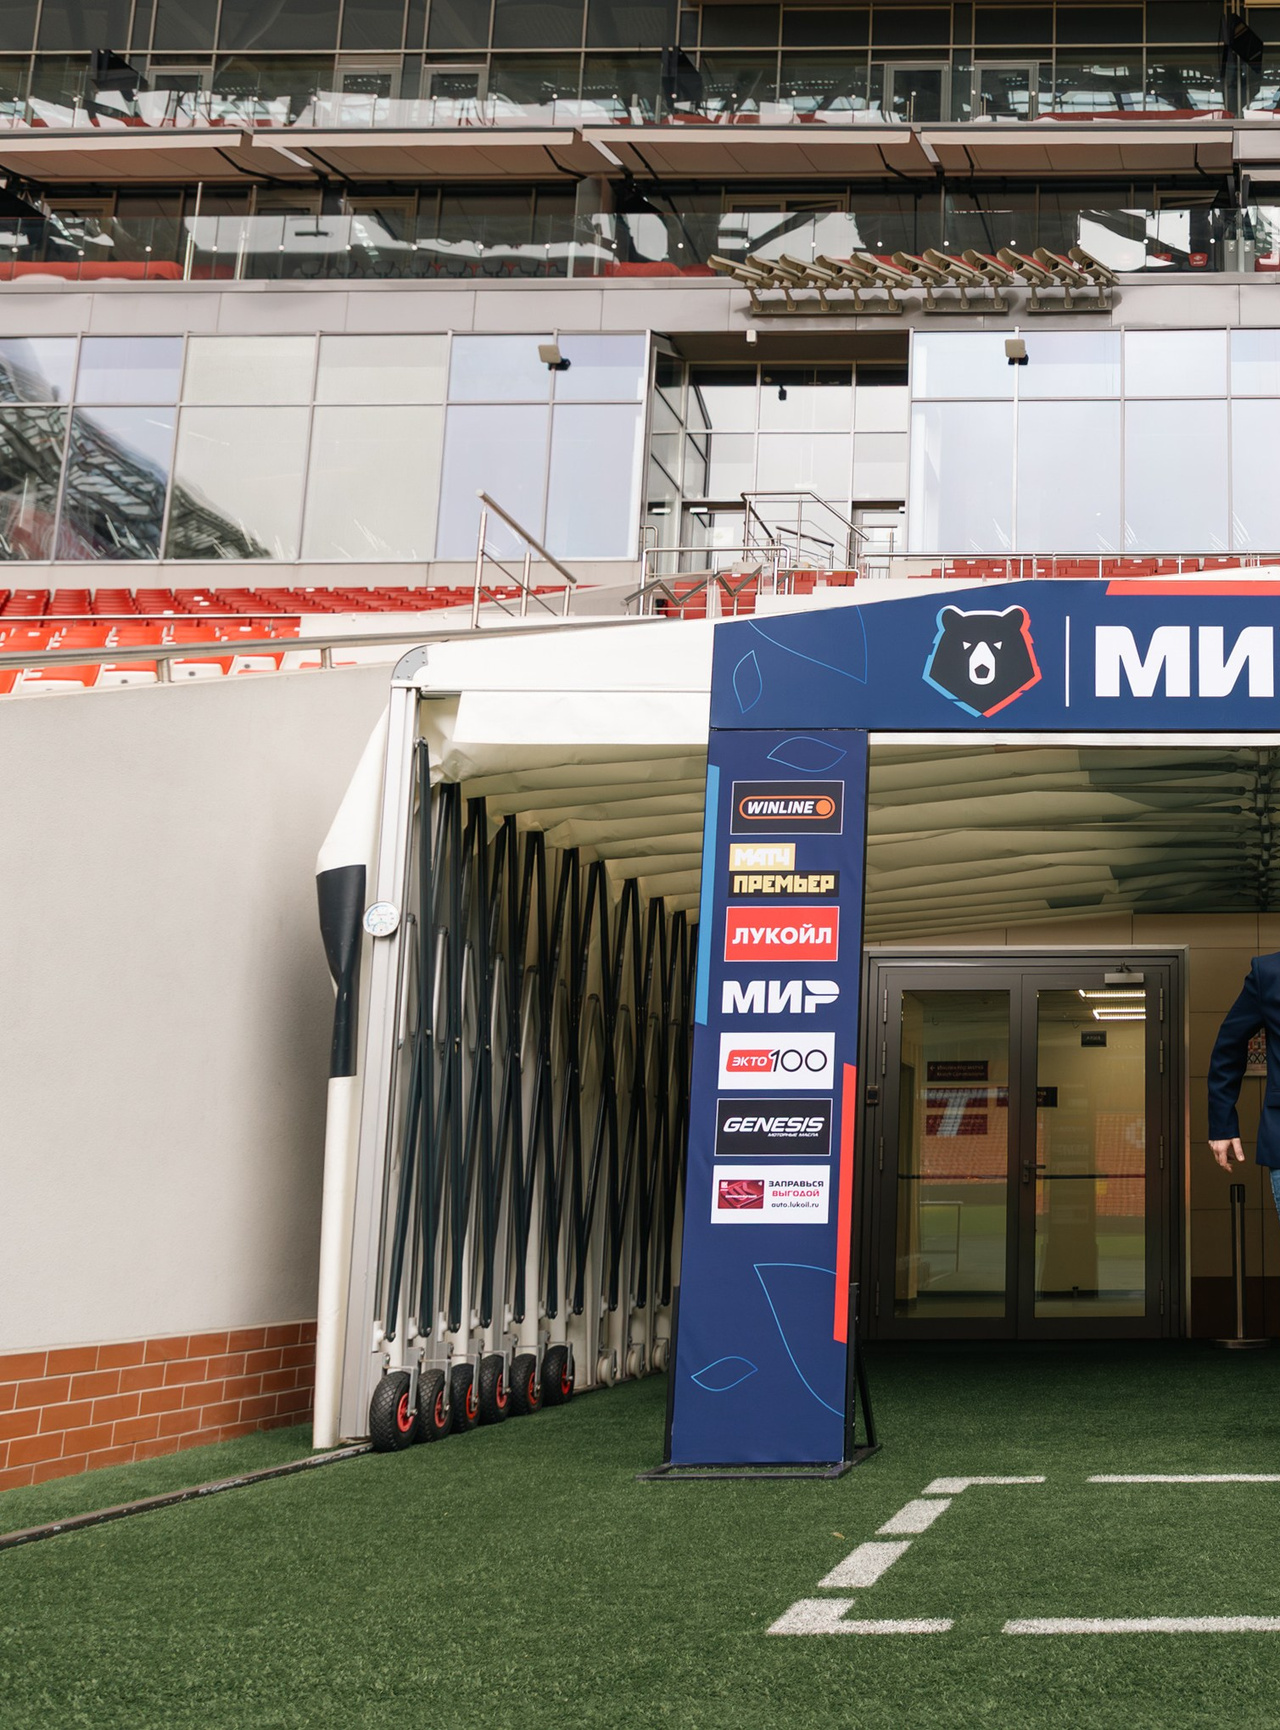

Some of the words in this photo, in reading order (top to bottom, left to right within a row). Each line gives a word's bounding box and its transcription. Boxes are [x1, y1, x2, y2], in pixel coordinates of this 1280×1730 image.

[747, 801, 815, 815] WINLINE
[733, 847, 791, 867] МАТЧ
[732, 874, 836, 894] ПРЕМЬЕР
[731, 923, 833, 945] ЛУКОЙЛ
[721, 980, 841, 1014] МИР
[723, 1117, 826, 1132] GENESIS
[772, 1189, 820, 1197] ВЫГОДОЙ
